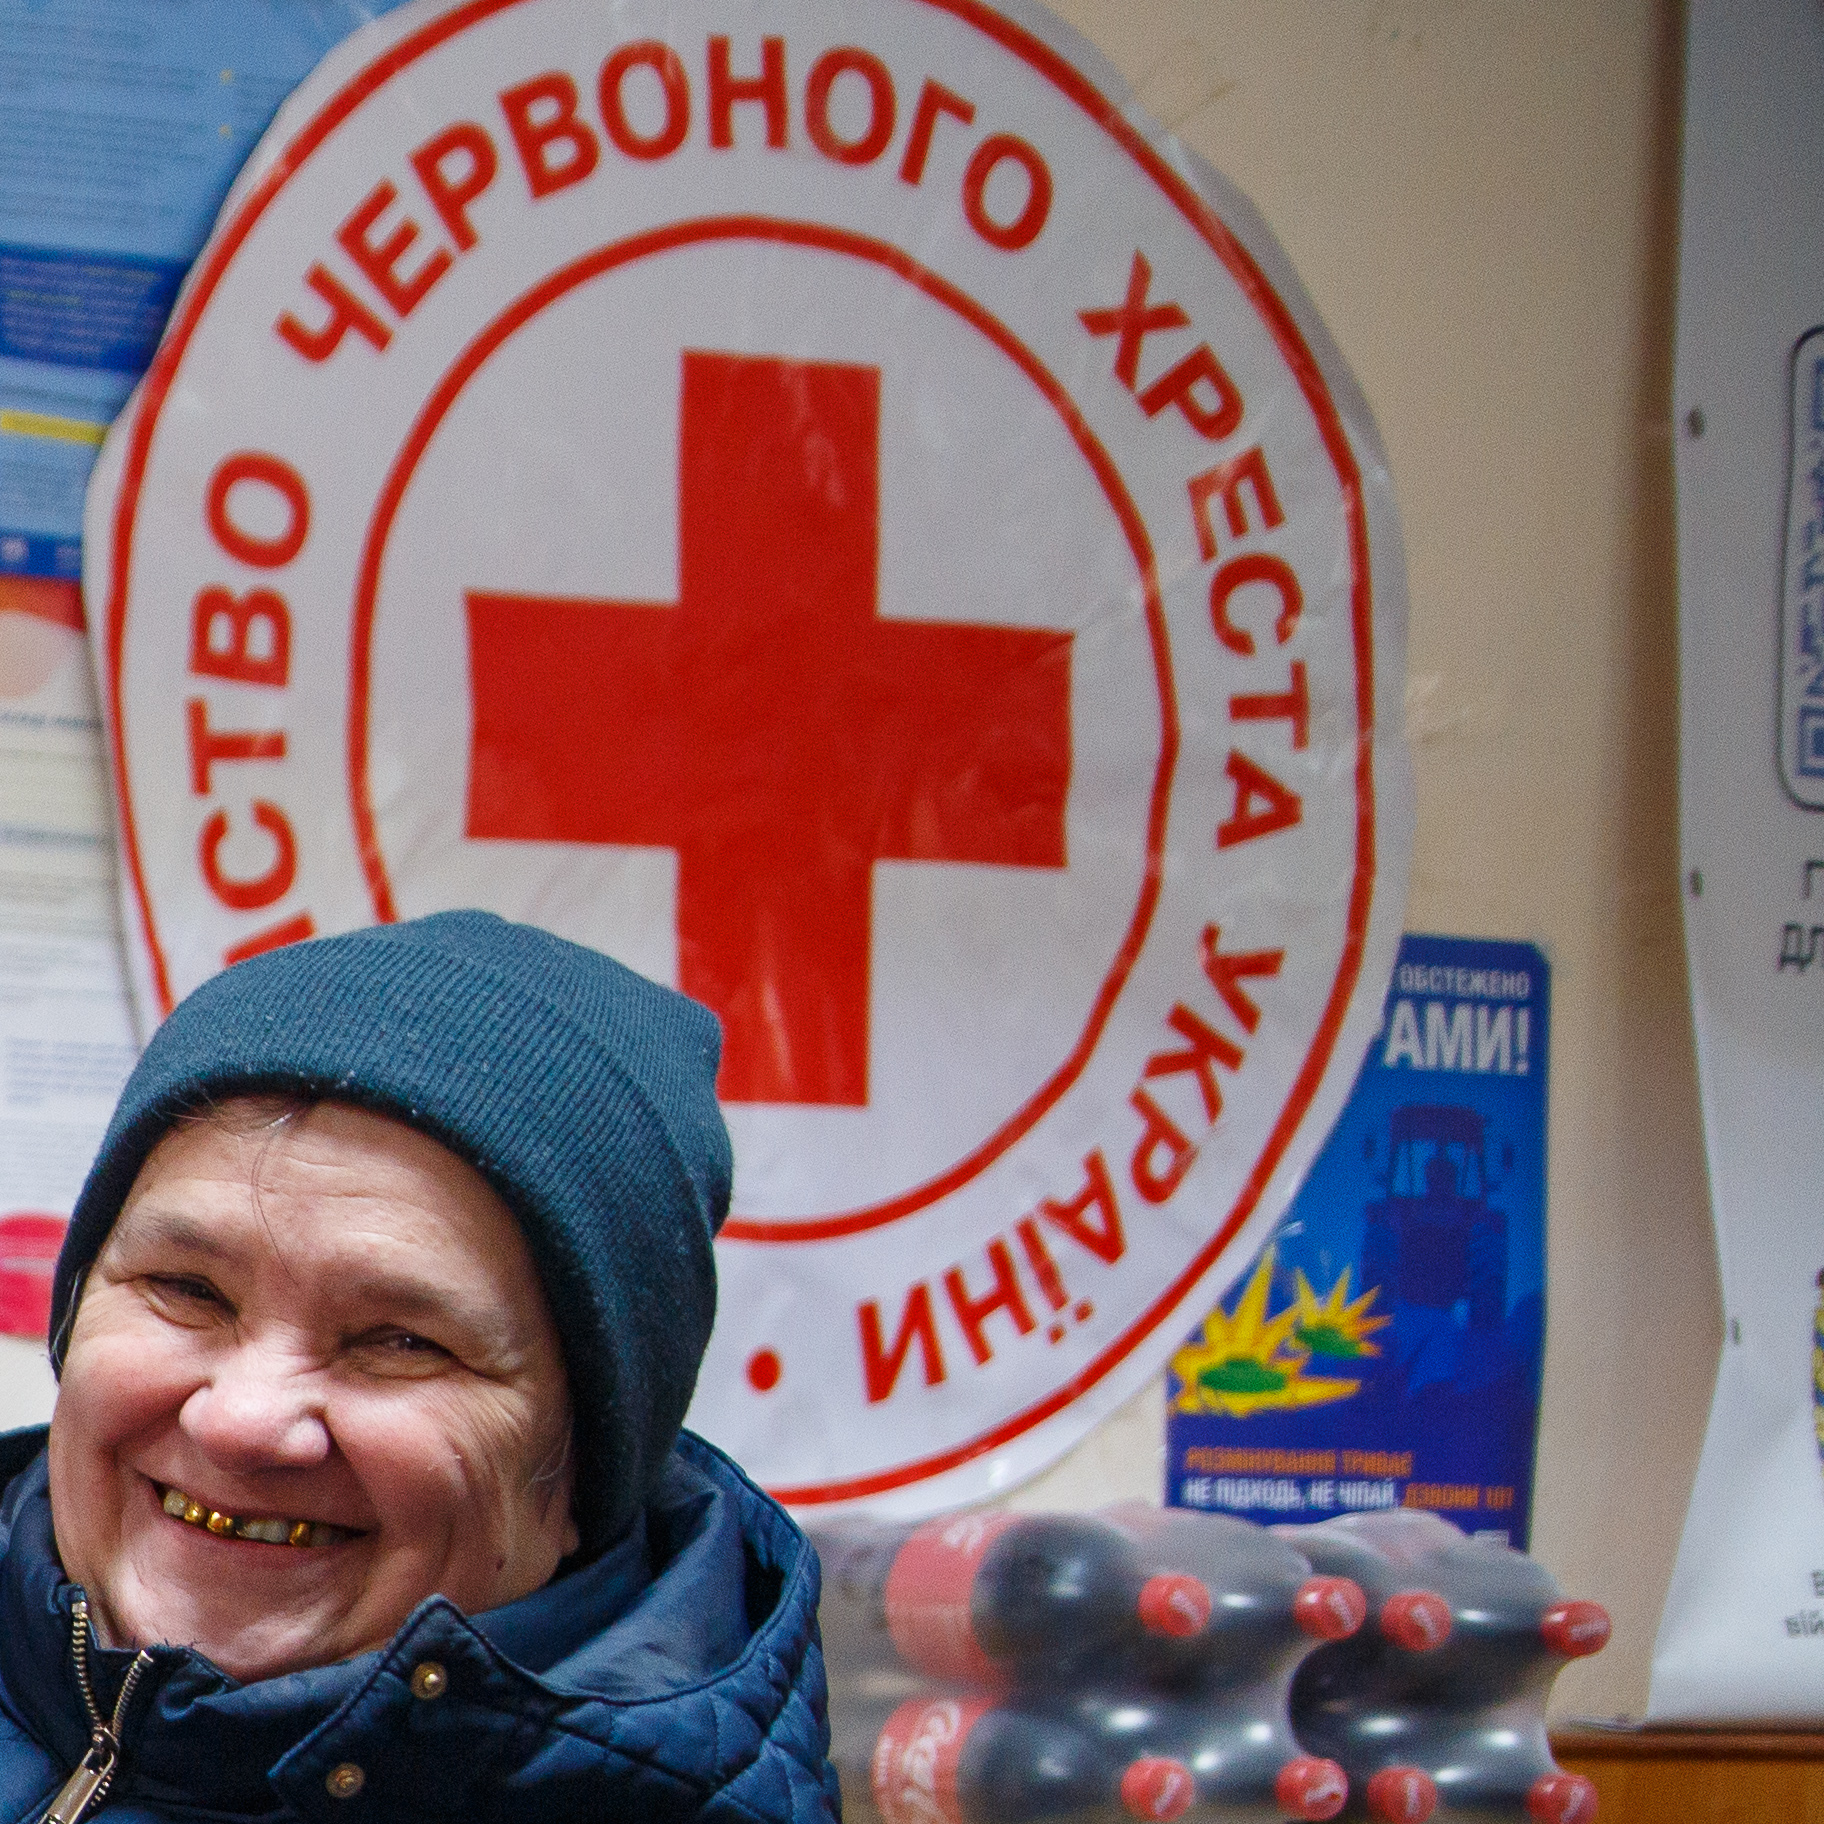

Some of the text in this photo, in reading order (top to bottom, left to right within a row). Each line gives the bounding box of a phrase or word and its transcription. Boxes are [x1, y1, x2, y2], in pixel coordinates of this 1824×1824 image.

[186, 34, 1310, 1407] СТВО ЧЕРВОНОГО ХРЕСТА УКРАЇНИ
[1400, 963, 1530, 999] ОБСТЕЖЕНО
[1383, 1000, 1530, 1076] АМИ!
[1184, 1477, 1211, 1504] НЕ
[1309, 1480, 1335, 1508] НЕ
